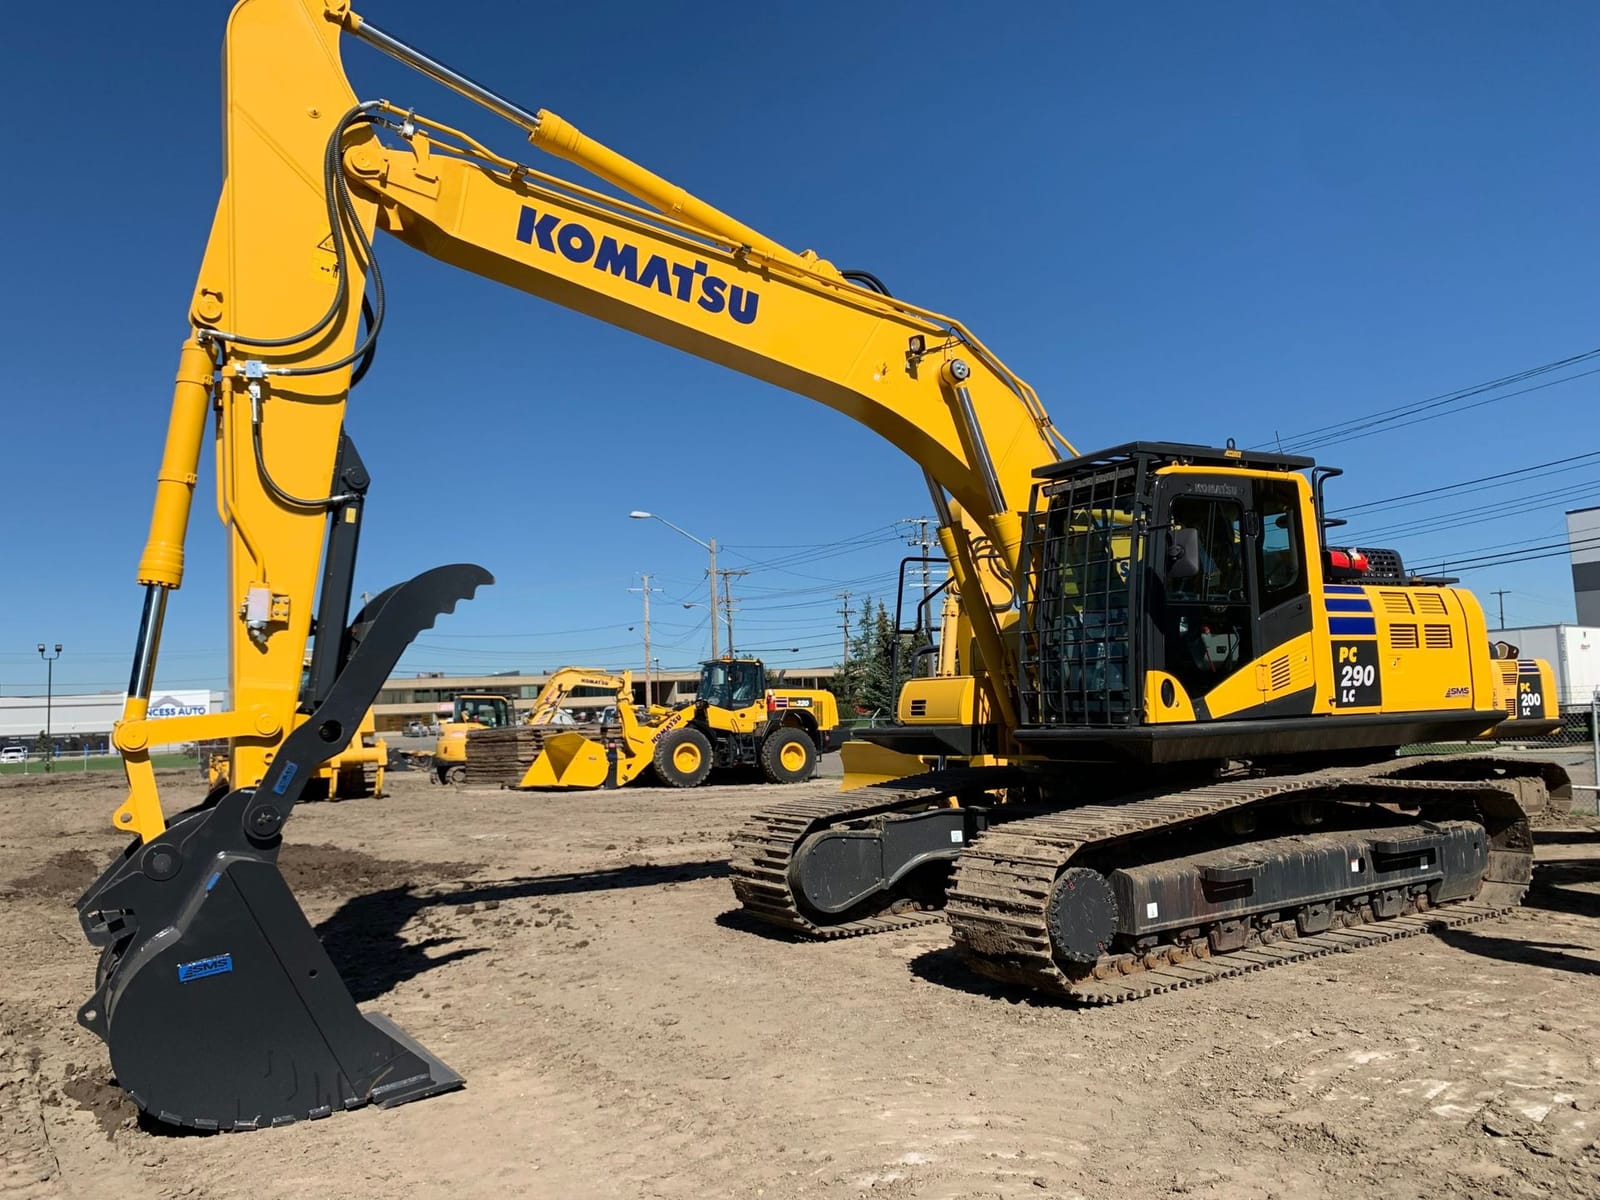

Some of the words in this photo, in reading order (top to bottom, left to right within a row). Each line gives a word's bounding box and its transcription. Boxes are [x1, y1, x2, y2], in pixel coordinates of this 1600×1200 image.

[516, 205, 760, 325] KOMATSU
[1194, 483, 1238, 496] KOMATSU
[1339, 646, 1358, 663] PC
[1341, 665, 1375, 687] 290
[1520, 682, 1531, 692] PC
[1342, 689, 1356, 703] LC
[1521, 693, 1540, 706] 200
[178, 707, 206, 715] AUTO
[1522, 707, 1531, 716] LC
[651, 715, 682, 745] KOMATSU
